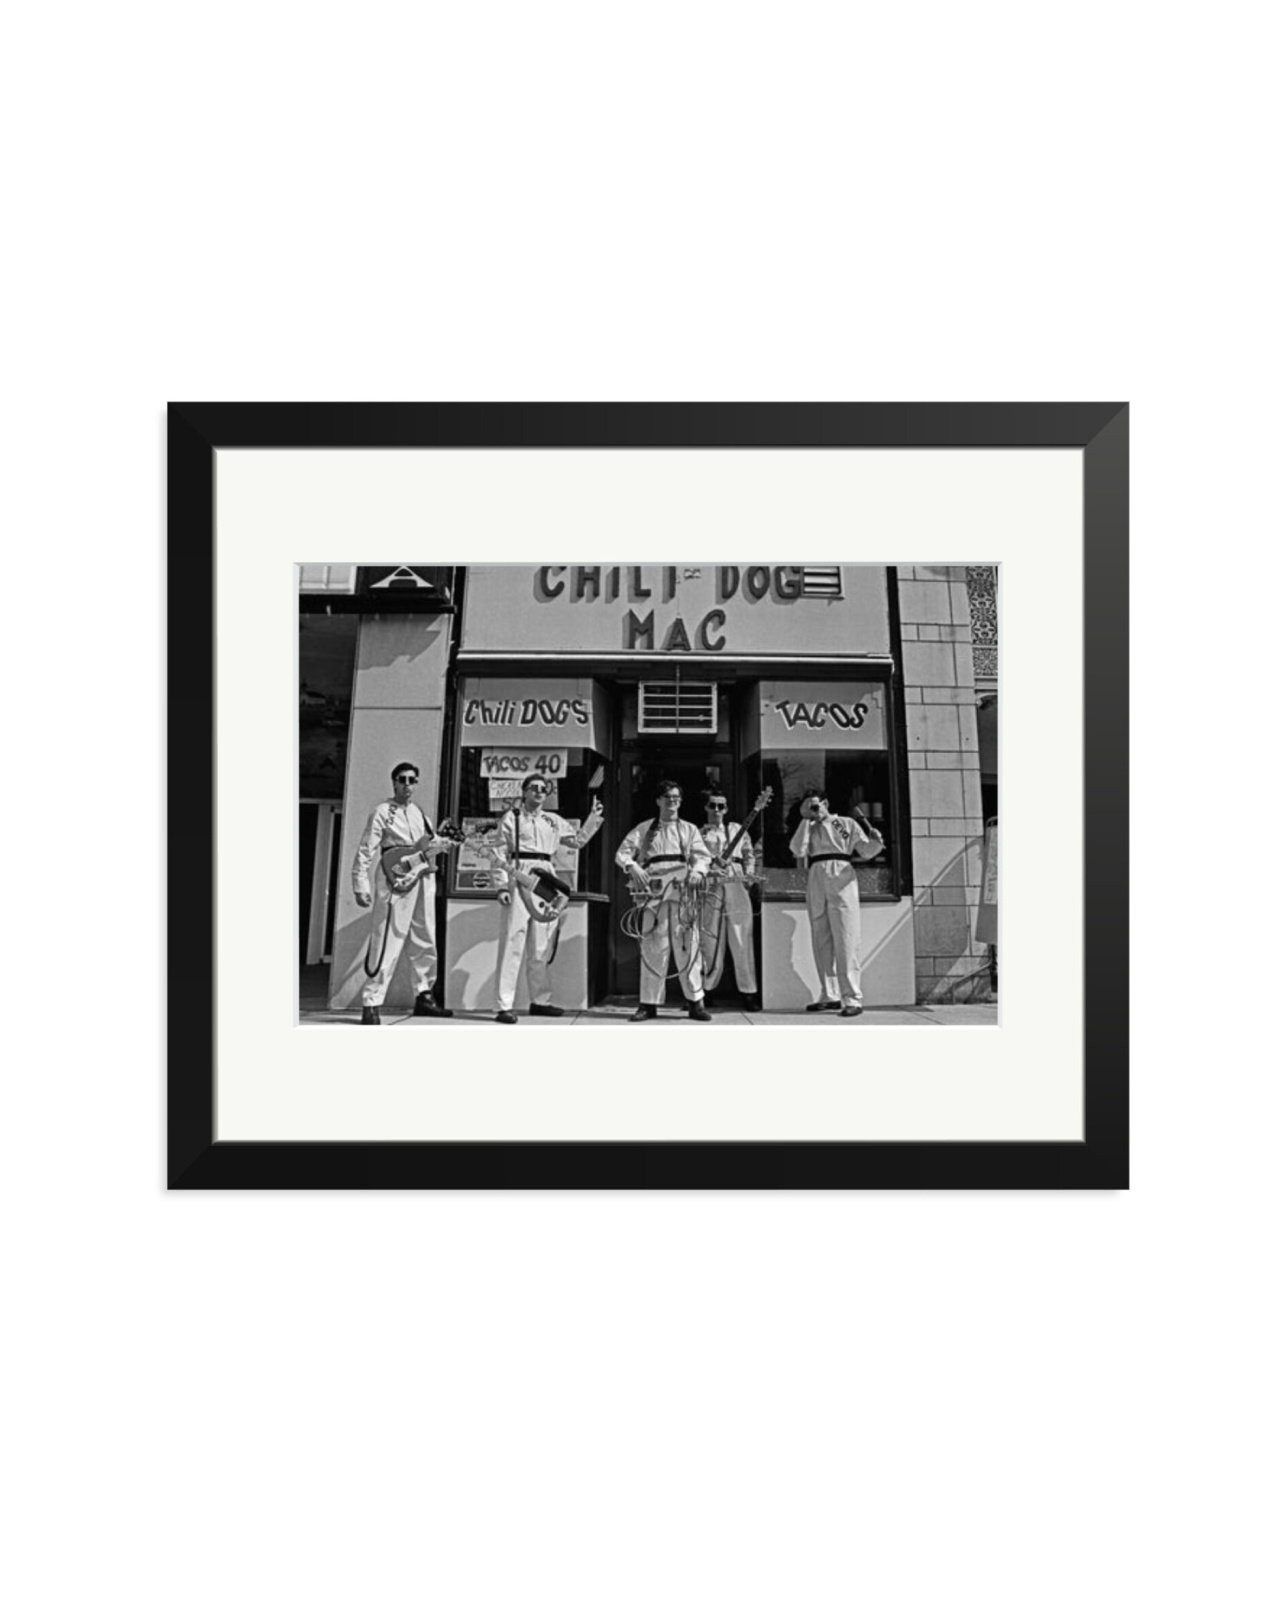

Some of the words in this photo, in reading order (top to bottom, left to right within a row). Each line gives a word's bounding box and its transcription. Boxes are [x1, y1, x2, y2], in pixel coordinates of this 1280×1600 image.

[533, 566, 677, 603] CHILI
[715, 566, 804, 605] DOG
[623, 608, 726, 651] MAC
[464, 698, 516, 725] Chili
[519, 698, 588, 725] DOGS
[776, 700, 868, 731] TACOS
[483, 755, 531, 773] TACOS
[535, 754, 561, 774] 40
